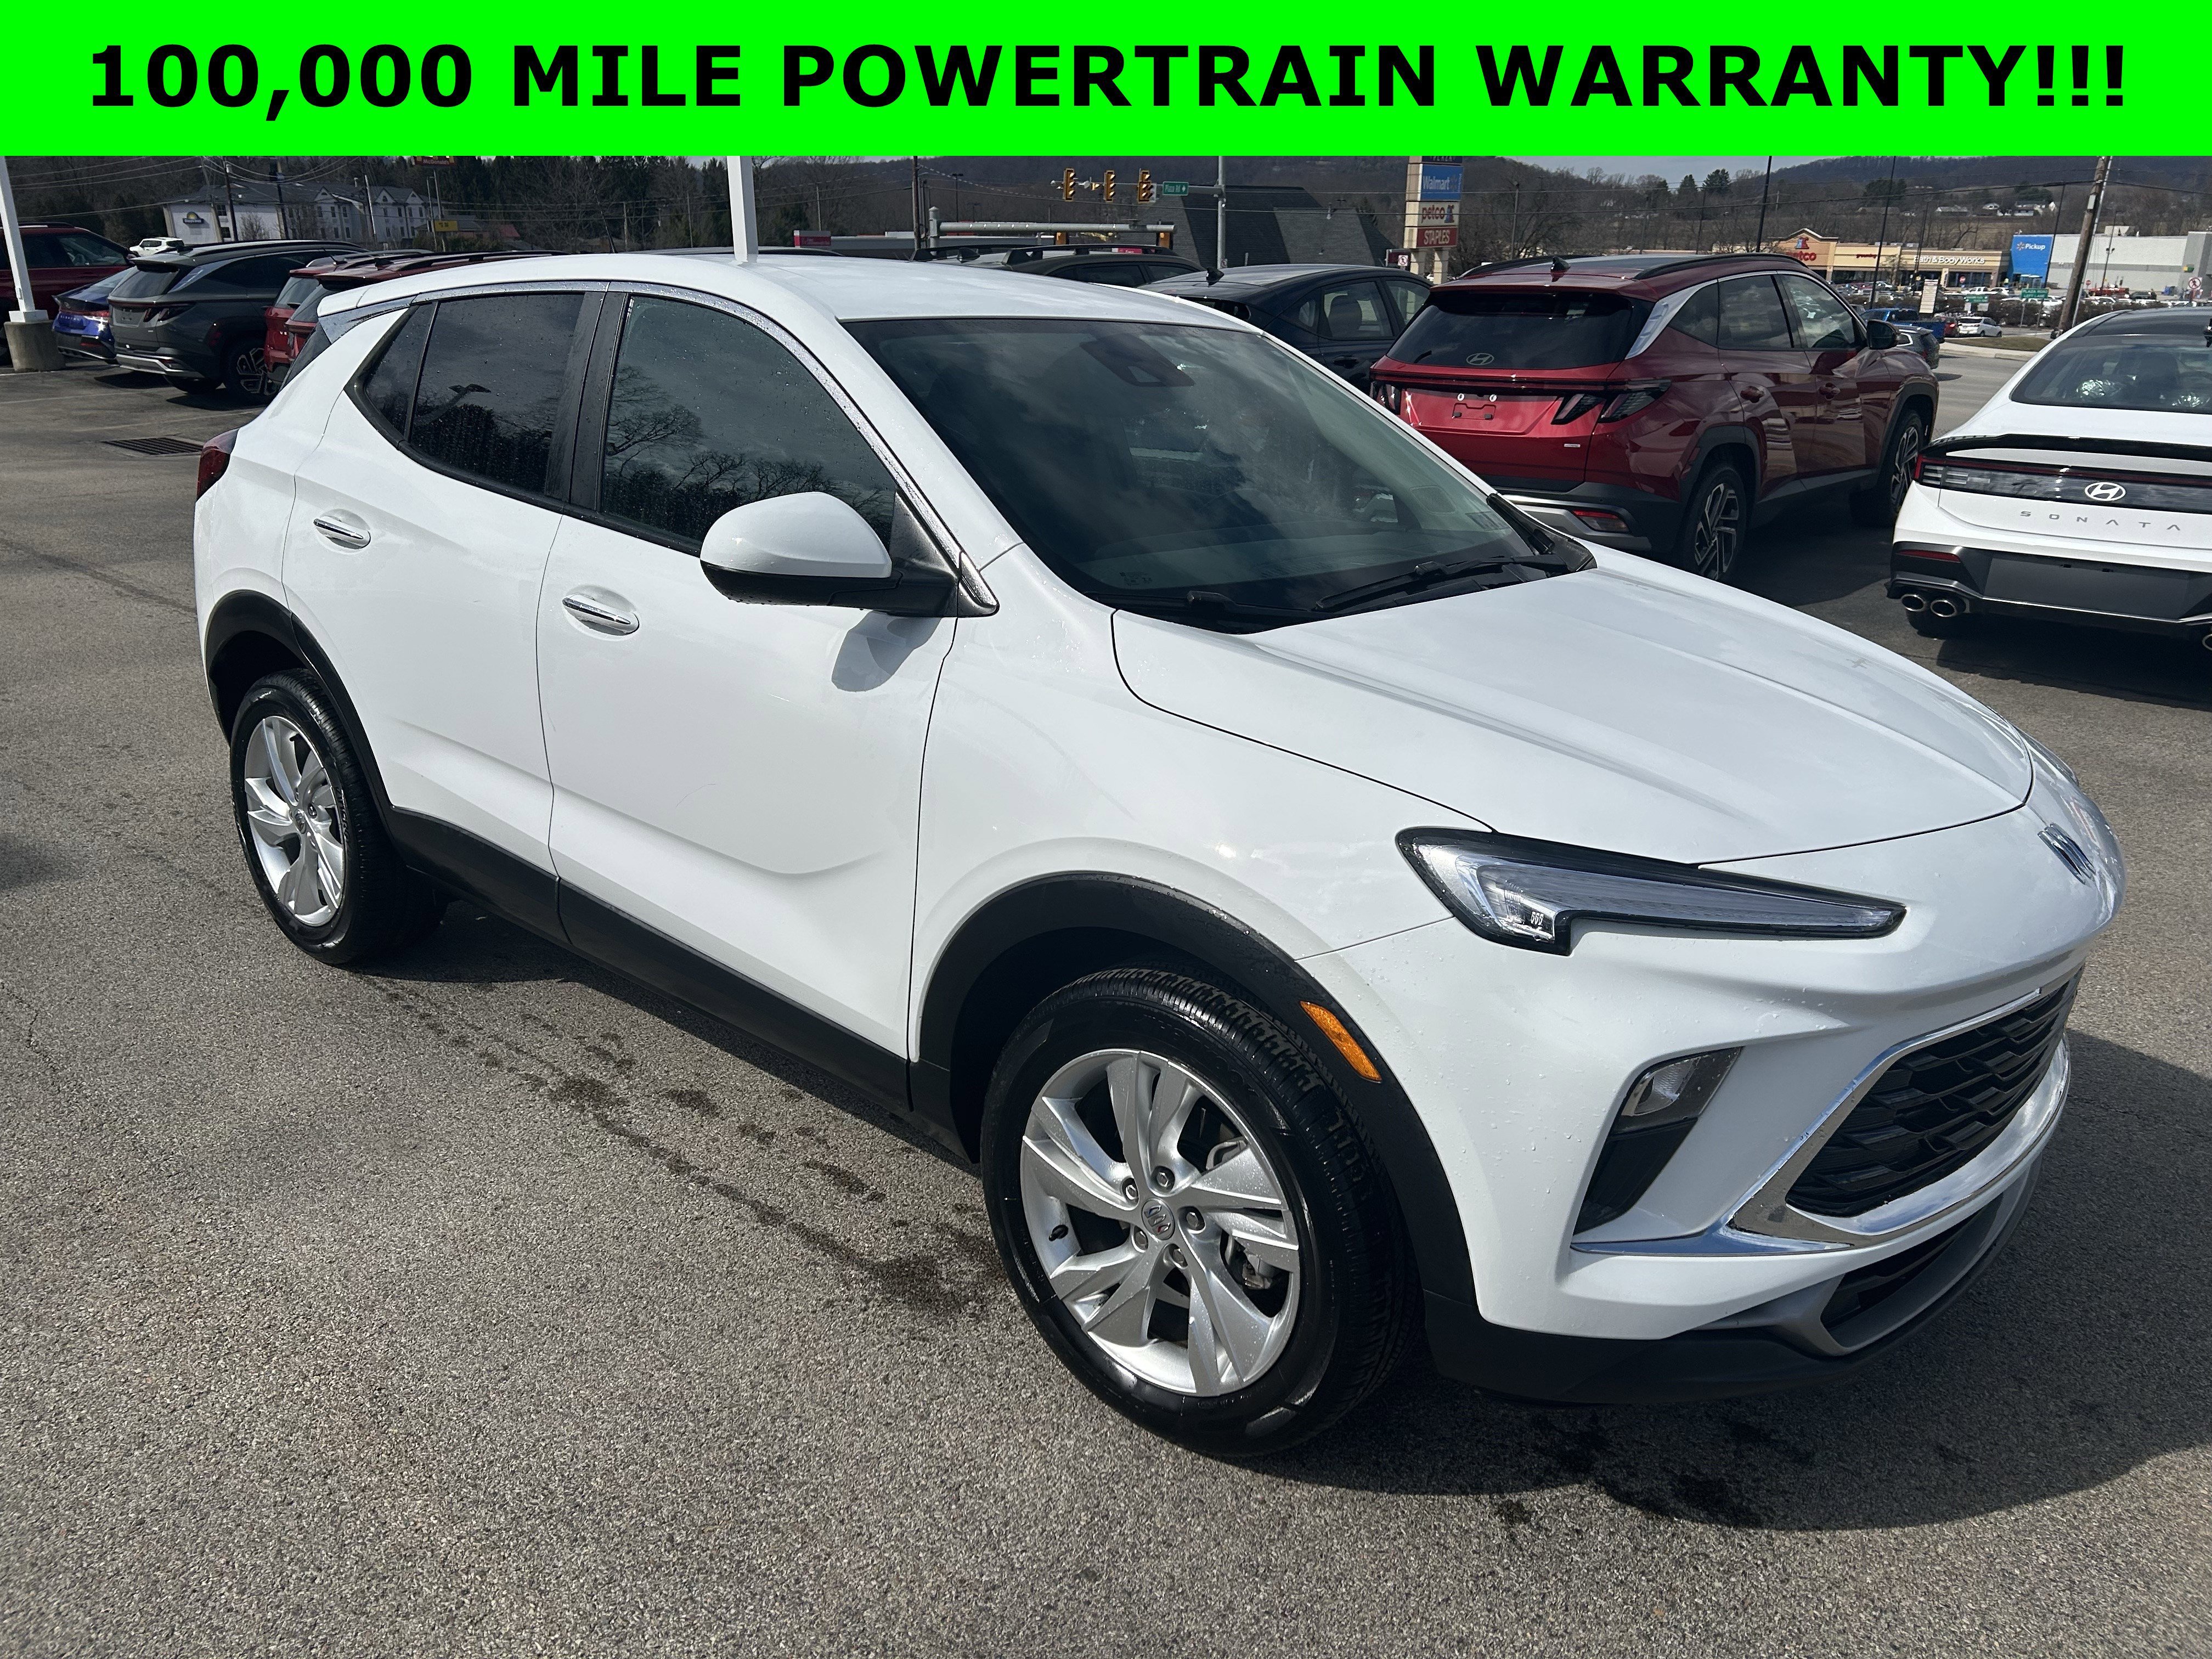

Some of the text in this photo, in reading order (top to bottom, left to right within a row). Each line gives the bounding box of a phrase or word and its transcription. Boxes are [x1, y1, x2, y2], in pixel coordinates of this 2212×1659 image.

[1423, 176, 1450, 190] Walmart
[1421, 205, 1445, 223] petco
[1424, 229, 1451, 245] STAPLES
[1939, 256, 1960, 265] Body
[2020, 510, 2181, 532] SONATA
